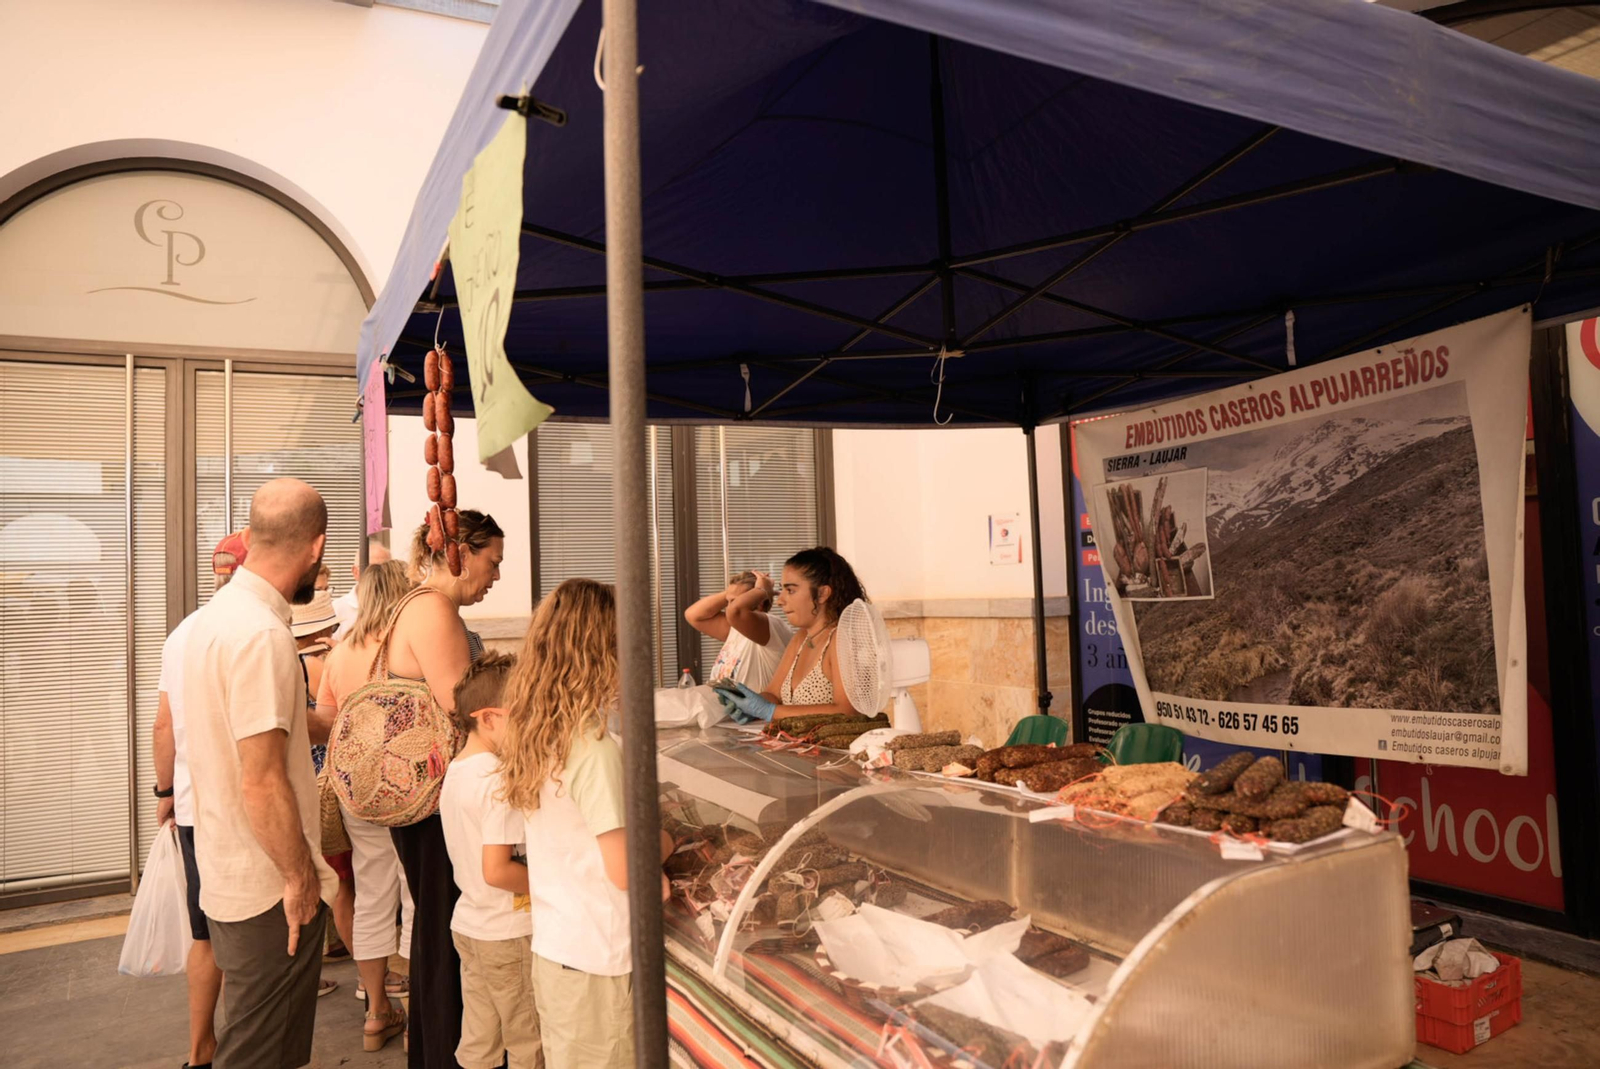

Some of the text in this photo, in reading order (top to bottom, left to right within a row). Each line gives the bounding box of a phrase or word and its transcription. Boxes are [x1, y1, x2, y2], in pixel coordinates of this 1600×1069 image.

[1125, 345, 1450, 449] EMBUTIDOS CASEROS ALPUJARREÑOS
[1107, 454, 1140, 472] SIERRA
[1149, 446, 1187, 465] LAUJAR
[1087, 643, 1098, 668] 3
[1156, 700, 1173, 718] 950
[1173, 703, 1184, 720] 51
[1185, 706, 1198, 723] 43
[1197, 708, 1210, 726] 72
[1218, 711, 1240, 730] 626
[1243, 713, 1258, 731] 57
[1262, 714, 1278, 733] 45
[1282, 716, 1299, 735] 65
[1391, 740, 1433, 754] Embutidos
[1435, 746, 1469, 757] caseros
